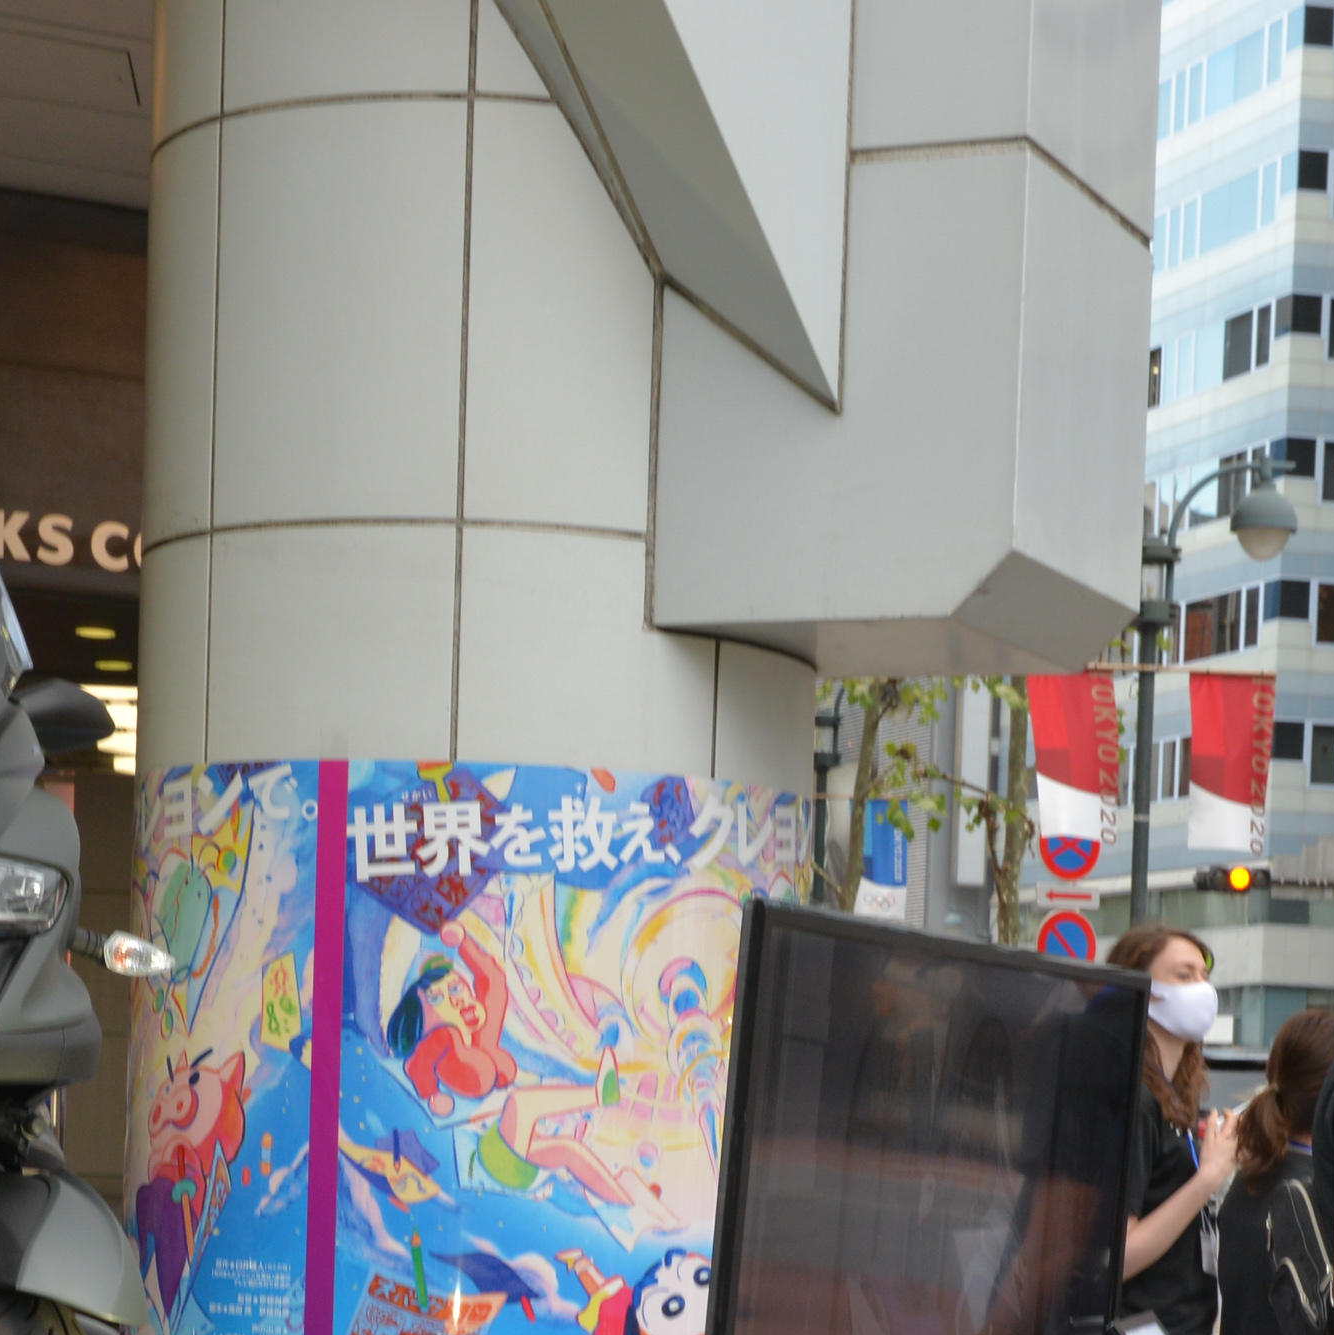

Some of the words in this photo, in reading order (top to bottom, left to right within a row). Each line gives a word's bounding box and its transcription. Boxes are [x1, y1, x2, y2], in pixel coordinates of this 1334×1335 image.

[90, 520, 142, 573] C
[1089, 671, 1120, 764] TOKYO
[1251, 677, 1276, 776] TOKYO
[1098, 768, 1120, 847] 2020
[1250, 778, 1268, 857] 2020
